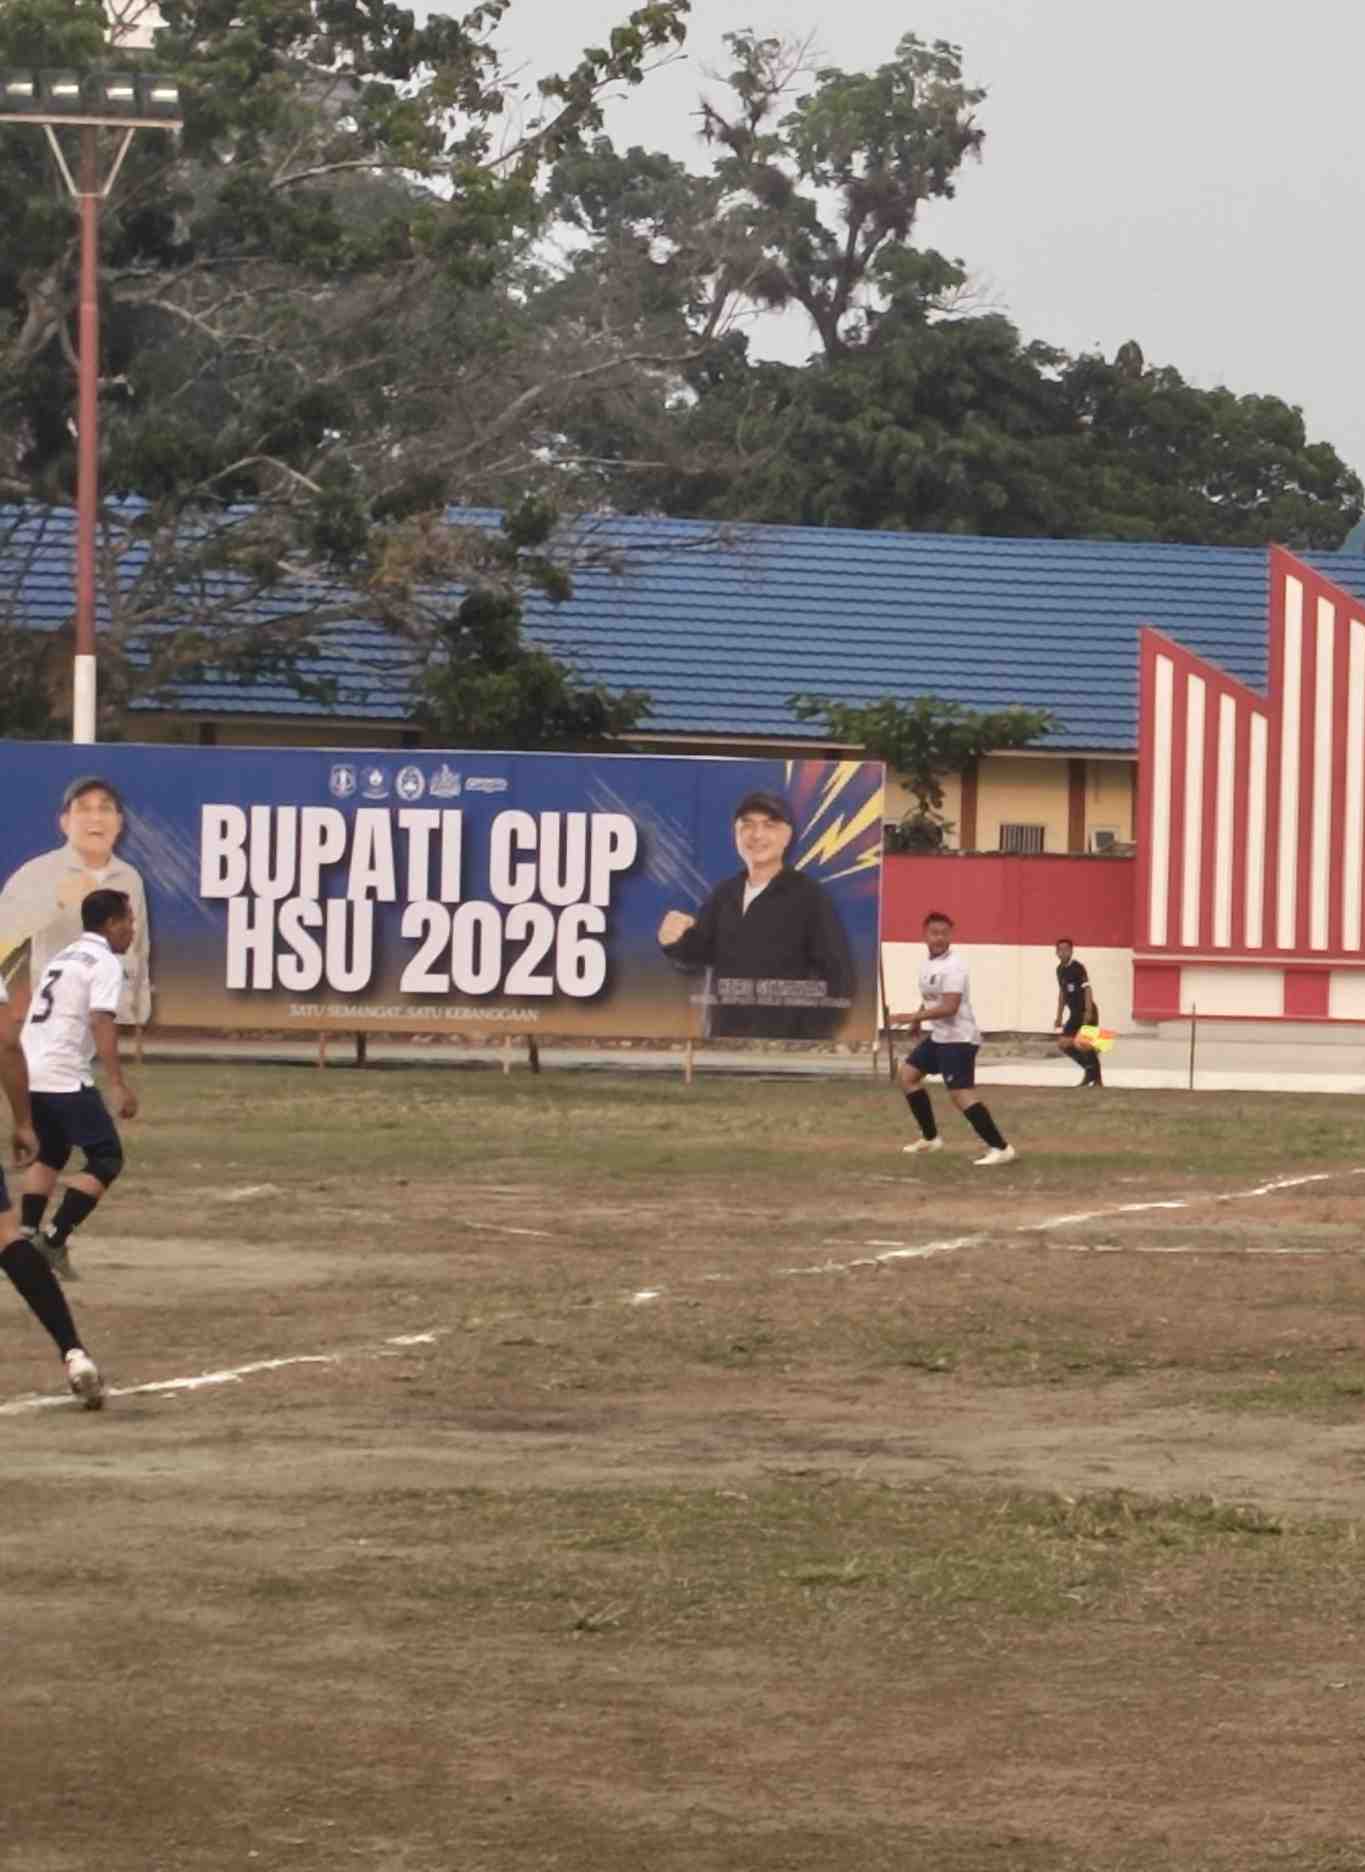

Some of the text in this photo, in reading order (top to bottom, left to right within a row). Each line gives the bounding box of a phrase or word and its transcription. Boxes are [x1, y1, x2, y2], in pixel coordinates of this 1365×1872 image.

[200, 804, 637, 906] BUPATI CUP
[31, 969, 62, 1023] 3
[226, 897, 606, 997] HSU 2026
